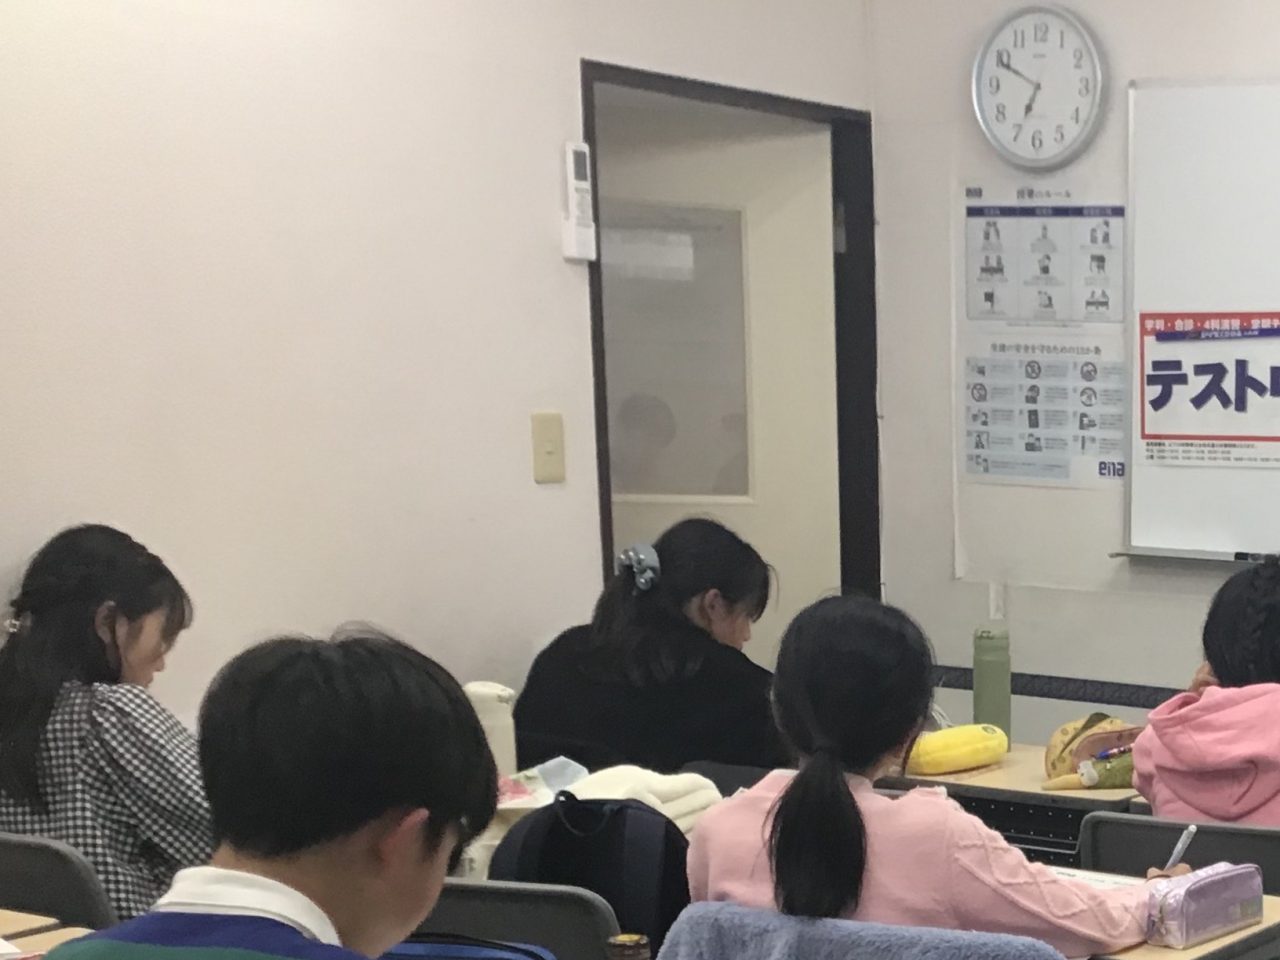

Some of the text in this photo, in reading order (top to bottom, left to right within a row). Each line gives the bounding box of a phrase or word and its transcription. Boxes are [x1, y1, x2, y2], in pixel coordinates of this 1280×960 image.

[1013, 28, 1025, 49] 11
[1033, 22, 1049, 43] 12
[995, 48, 1011, 69] 10
[1073, 48, 1084, 69] 2
[989, 75, 1000, 95] 9
[1078, 76, 1090, 98] 3
[995, 103, 1007, 123] 8
[1071, 106, 1080, 124] 4
[1012, 123, 1023, 142] 7
[1031, 129, 1043, 150] 6
[1054, 124, 1065, 143] 5
[1098, 460, 1126, 478] ena
